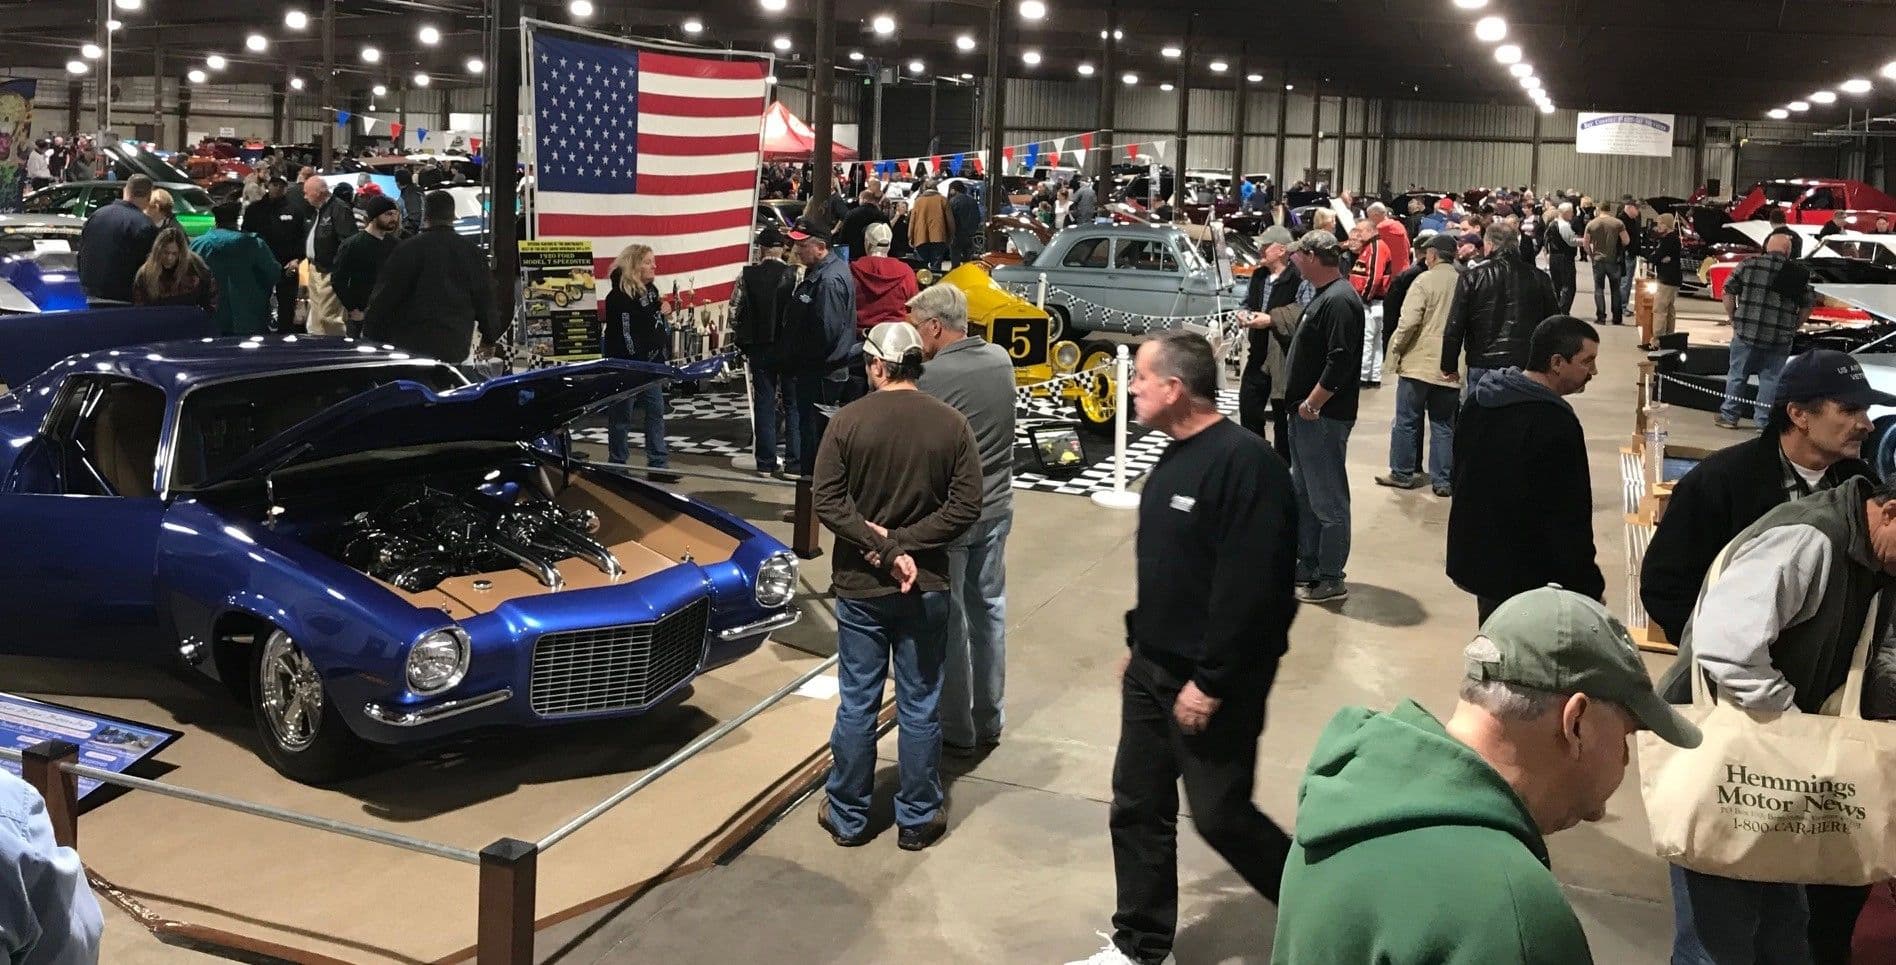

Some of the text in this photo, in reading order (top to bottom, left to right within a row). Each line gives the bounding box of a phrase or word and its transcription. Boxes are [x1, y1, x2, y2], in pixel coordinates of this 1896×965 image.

[1008, 323, 1031, 359] 5
[1837, 366, 1848, 375] US
[1725, 764, 1856, 799] Hemmings
[1716, 784, 1866, 820] Motor News
